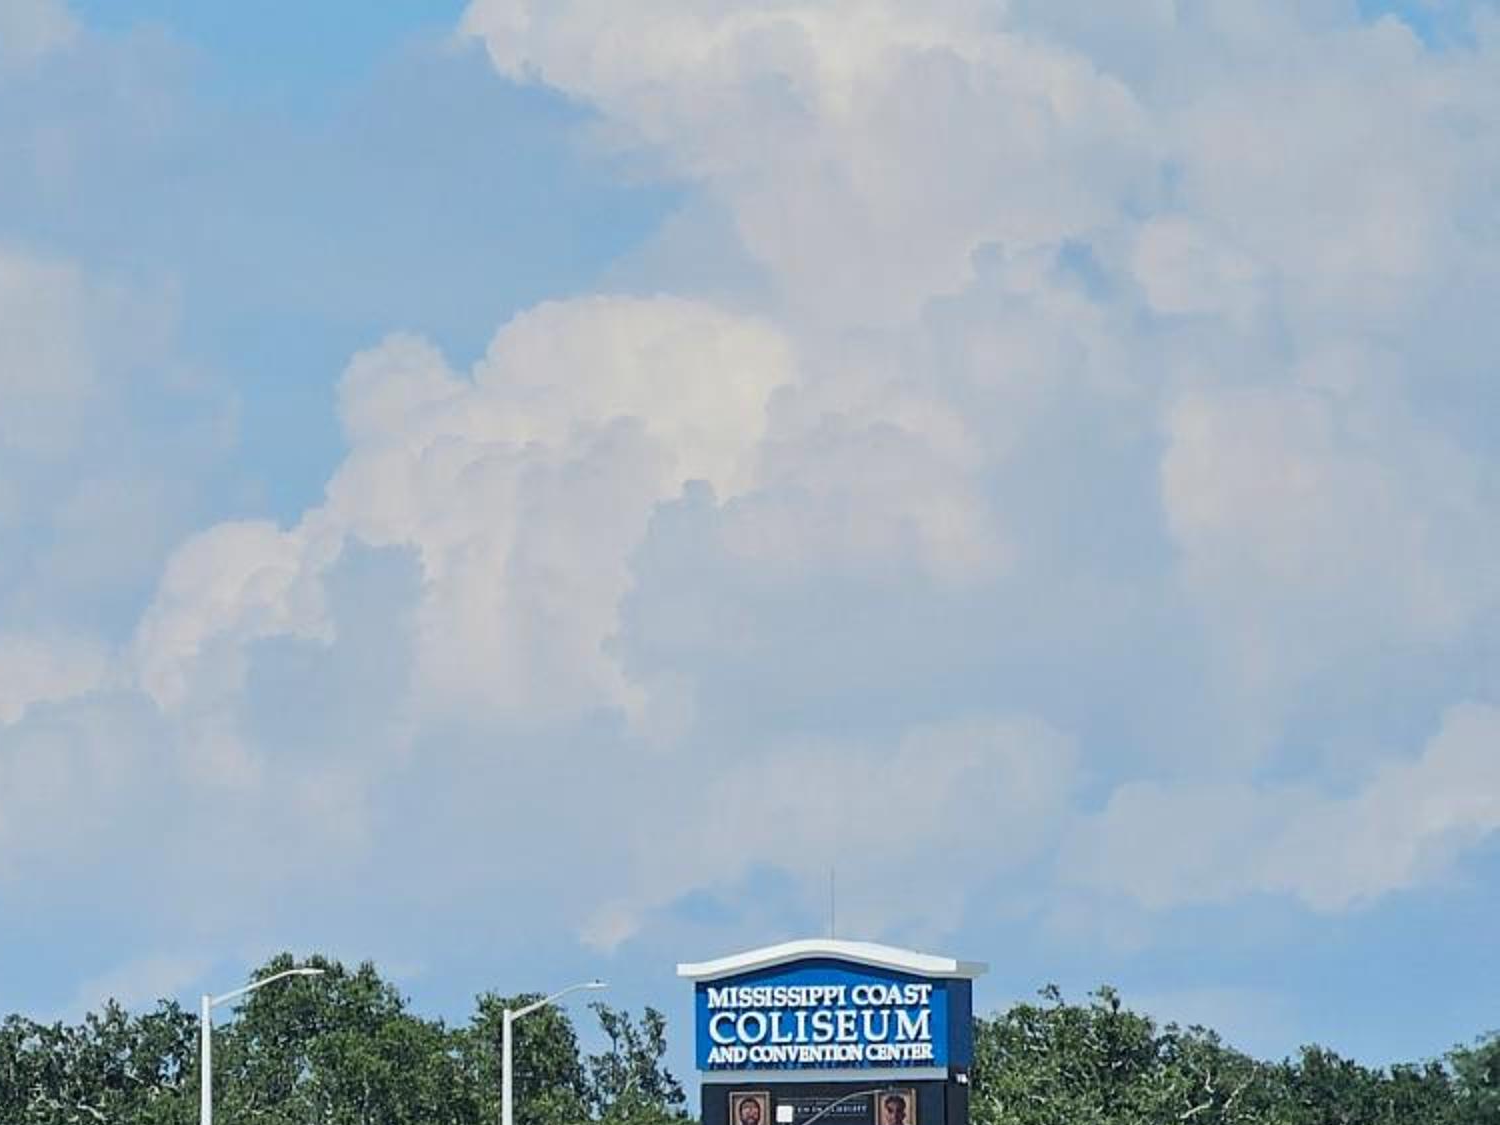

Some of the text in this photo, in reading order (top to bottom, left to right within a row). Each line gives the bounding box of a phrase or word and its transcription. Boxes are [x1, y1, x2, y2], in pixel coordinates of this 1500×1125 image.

[707, 983, 933, 1009] MISSISSIPPI COAST
[708, 1008, 933, 1044] COLISEUM
[707, 1042, 934, 1064] AND CONVENTION CENTER
